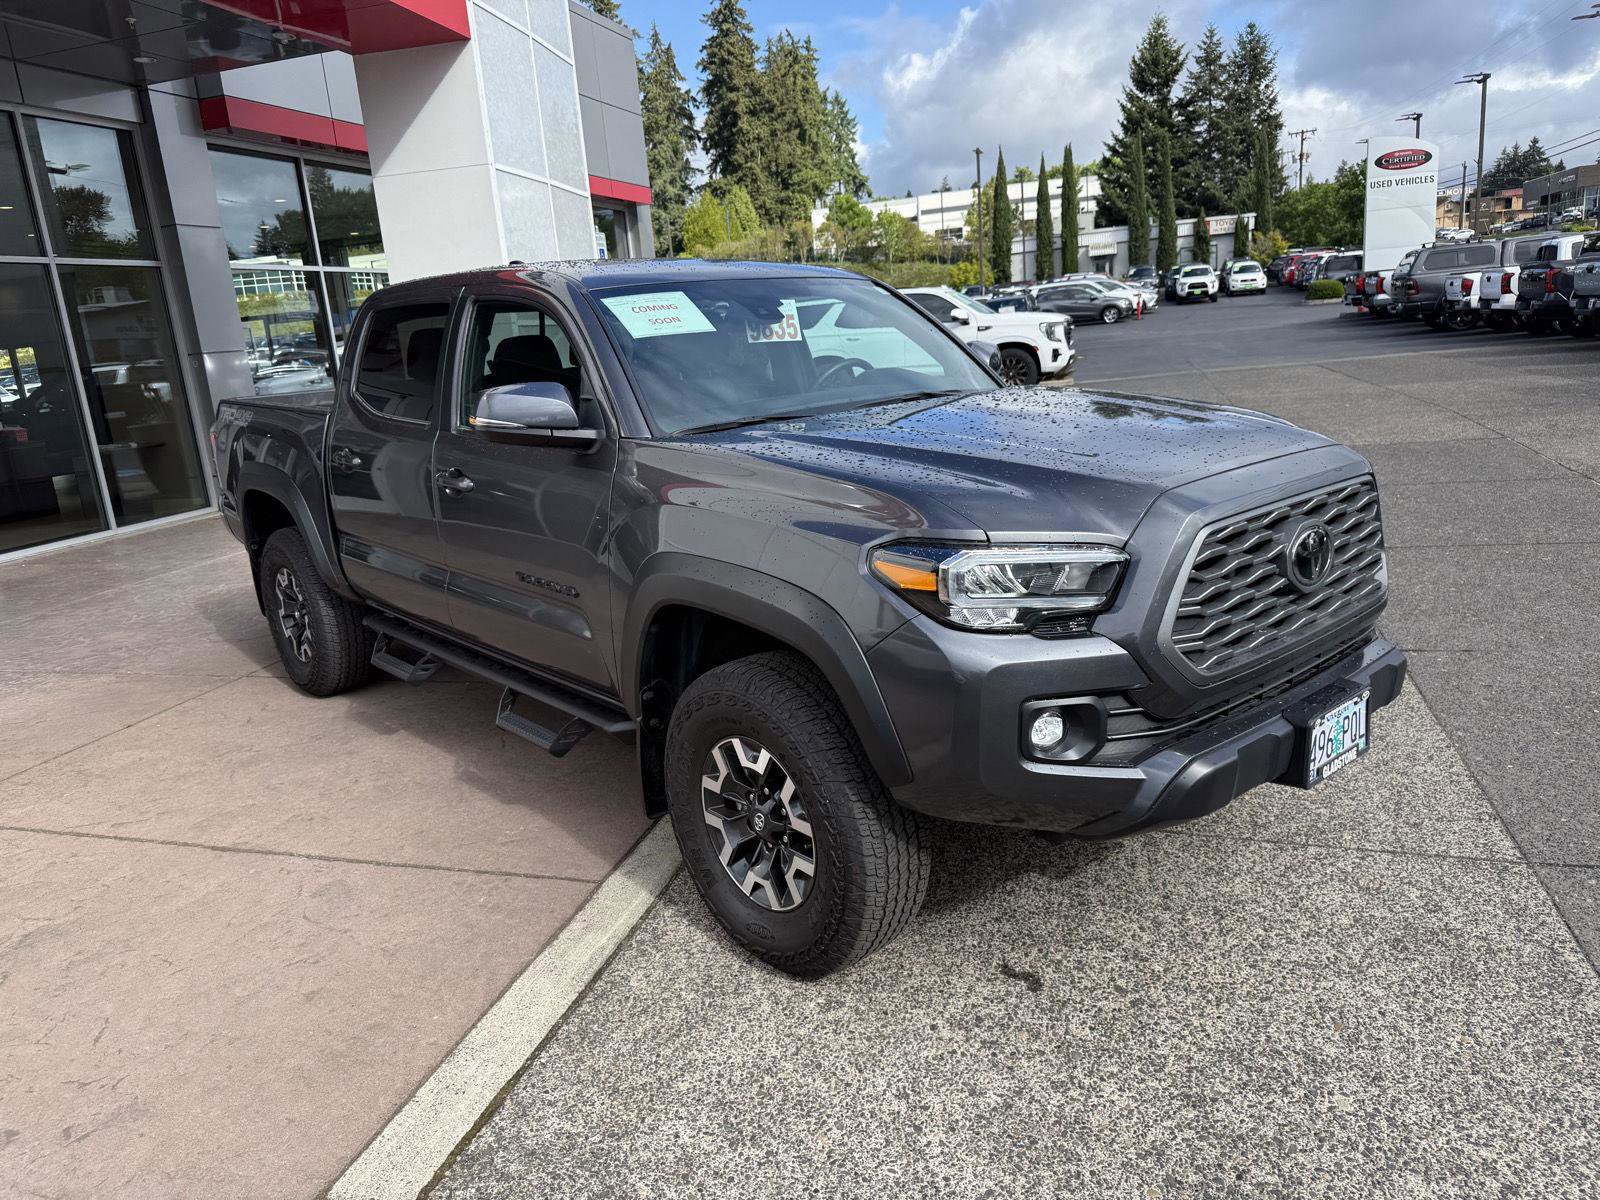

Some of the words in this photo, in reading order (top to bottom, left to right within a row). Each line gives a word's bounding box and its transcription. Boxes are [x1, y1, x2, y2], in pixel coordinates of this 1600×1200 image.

[1381, 154, 1426, 165] CERTIFIED
[1370, 179, 1393, 189] USED
[1395, 175, 1435, 187] VEHICLES
[631, 303, 678, 314] COMING
[648, 316, 682, 325] SOON
[1342, 707, 1365, 750] PQL
[1322, 747, 1358, 779] GLADSTONE
